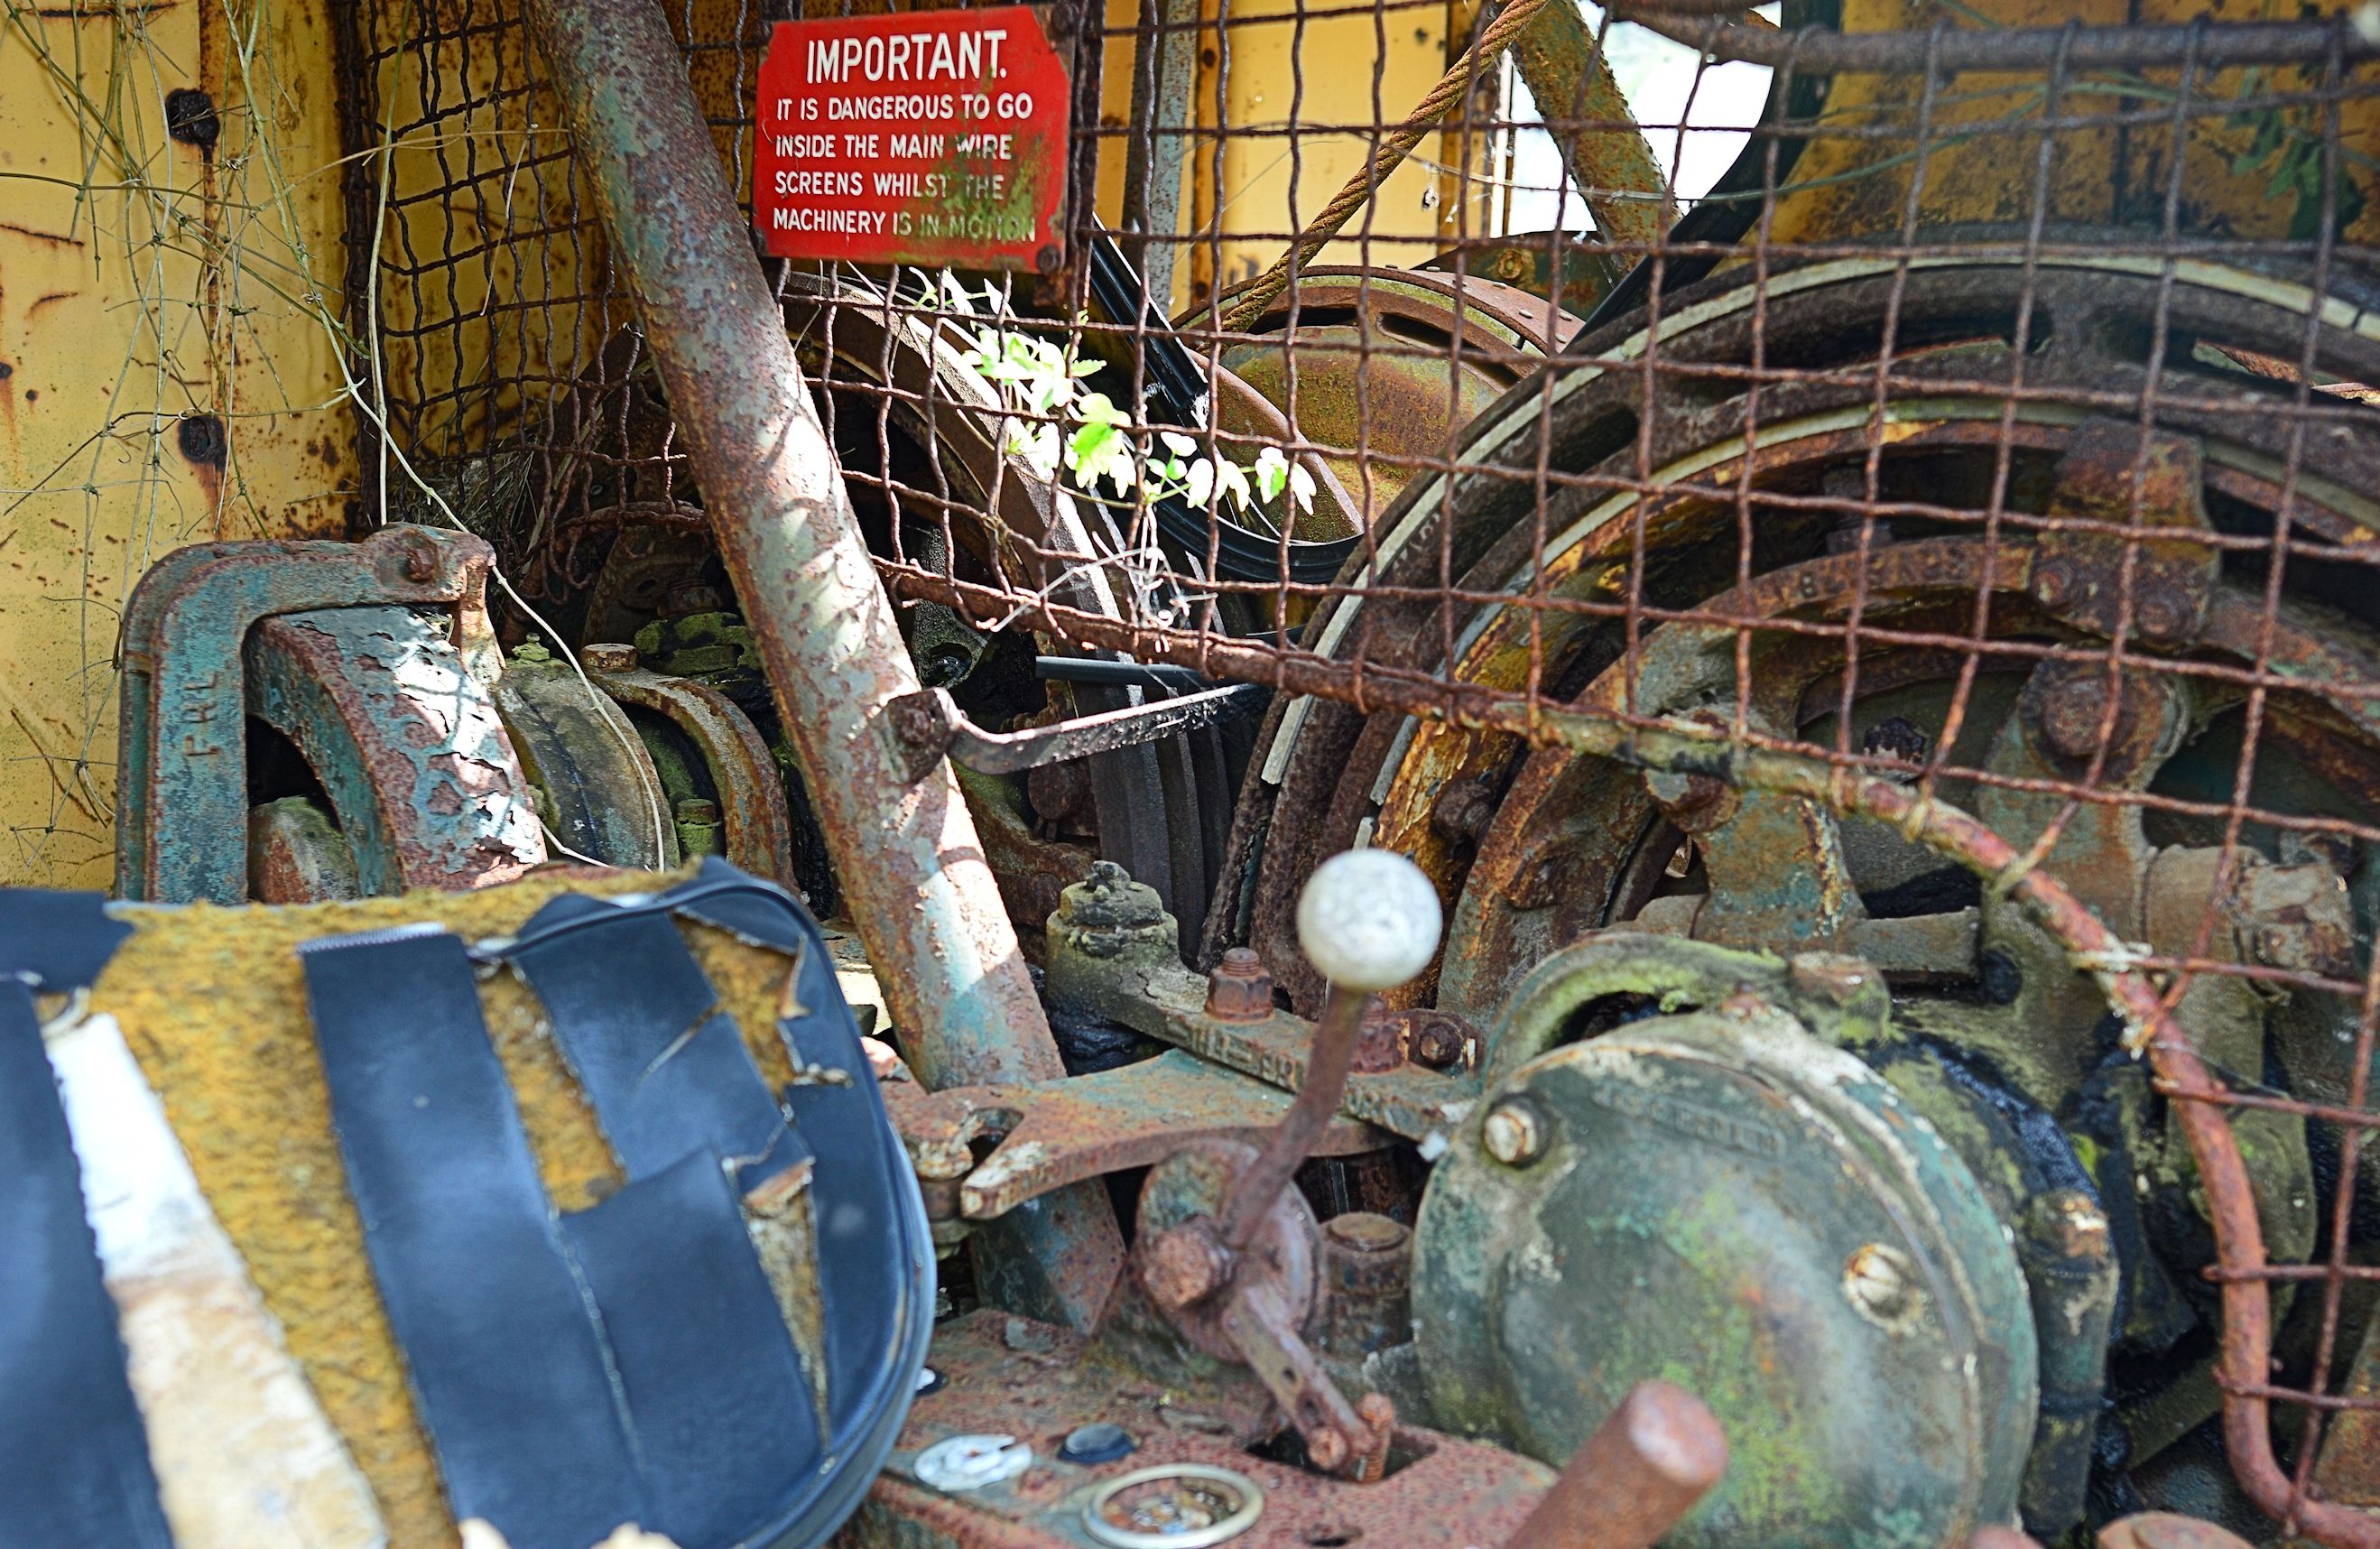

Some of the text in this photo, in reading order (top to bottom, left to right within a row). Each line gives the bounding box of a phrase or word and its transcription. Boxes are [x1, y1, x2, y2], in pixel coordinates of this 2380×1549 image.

[807, 30, 1007, 84] IMPORTANT.
[777, 92, 1033, 121] IT IS DANGEROUS TO GO
[776, 134, 1012, 160] INSIDE THE MAIN WIRE
[775, 172, 1004, 199] SCREENS WHILST THE
[773, 208, 885, 234] MACHINERY
[893, 212, 912, 236] IS
[921, 215, 939, 237] IN
